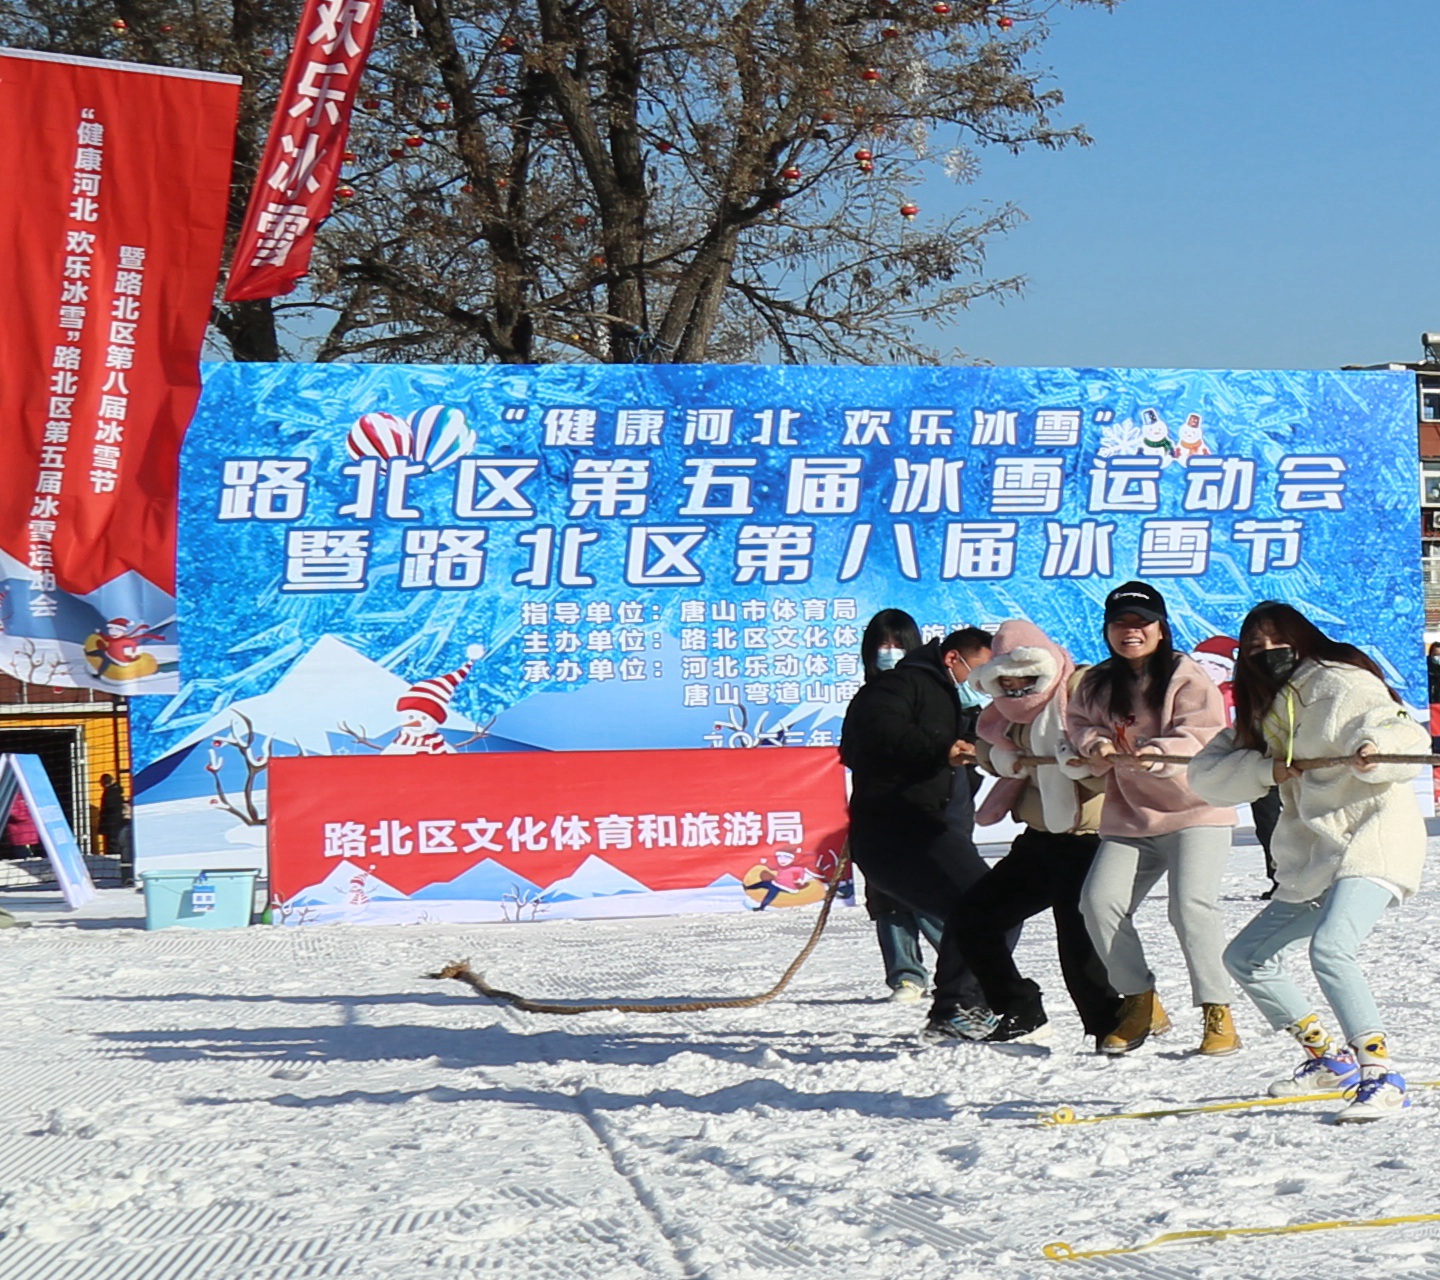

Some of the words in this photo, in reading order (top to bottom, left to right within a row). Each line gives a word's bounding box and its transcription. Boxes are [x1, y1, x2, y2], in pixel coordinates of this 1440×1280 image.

[89, 245, 146, 494] 暨路北区第八届冰雪节
[218, 456, 1347, 520] 路北区第五届冰雪运动会
[281, 520, 1303, 591] 暨路北区第八届冰雪节
[323, 811, 804, 858] 路北区文化体育和旅游局
